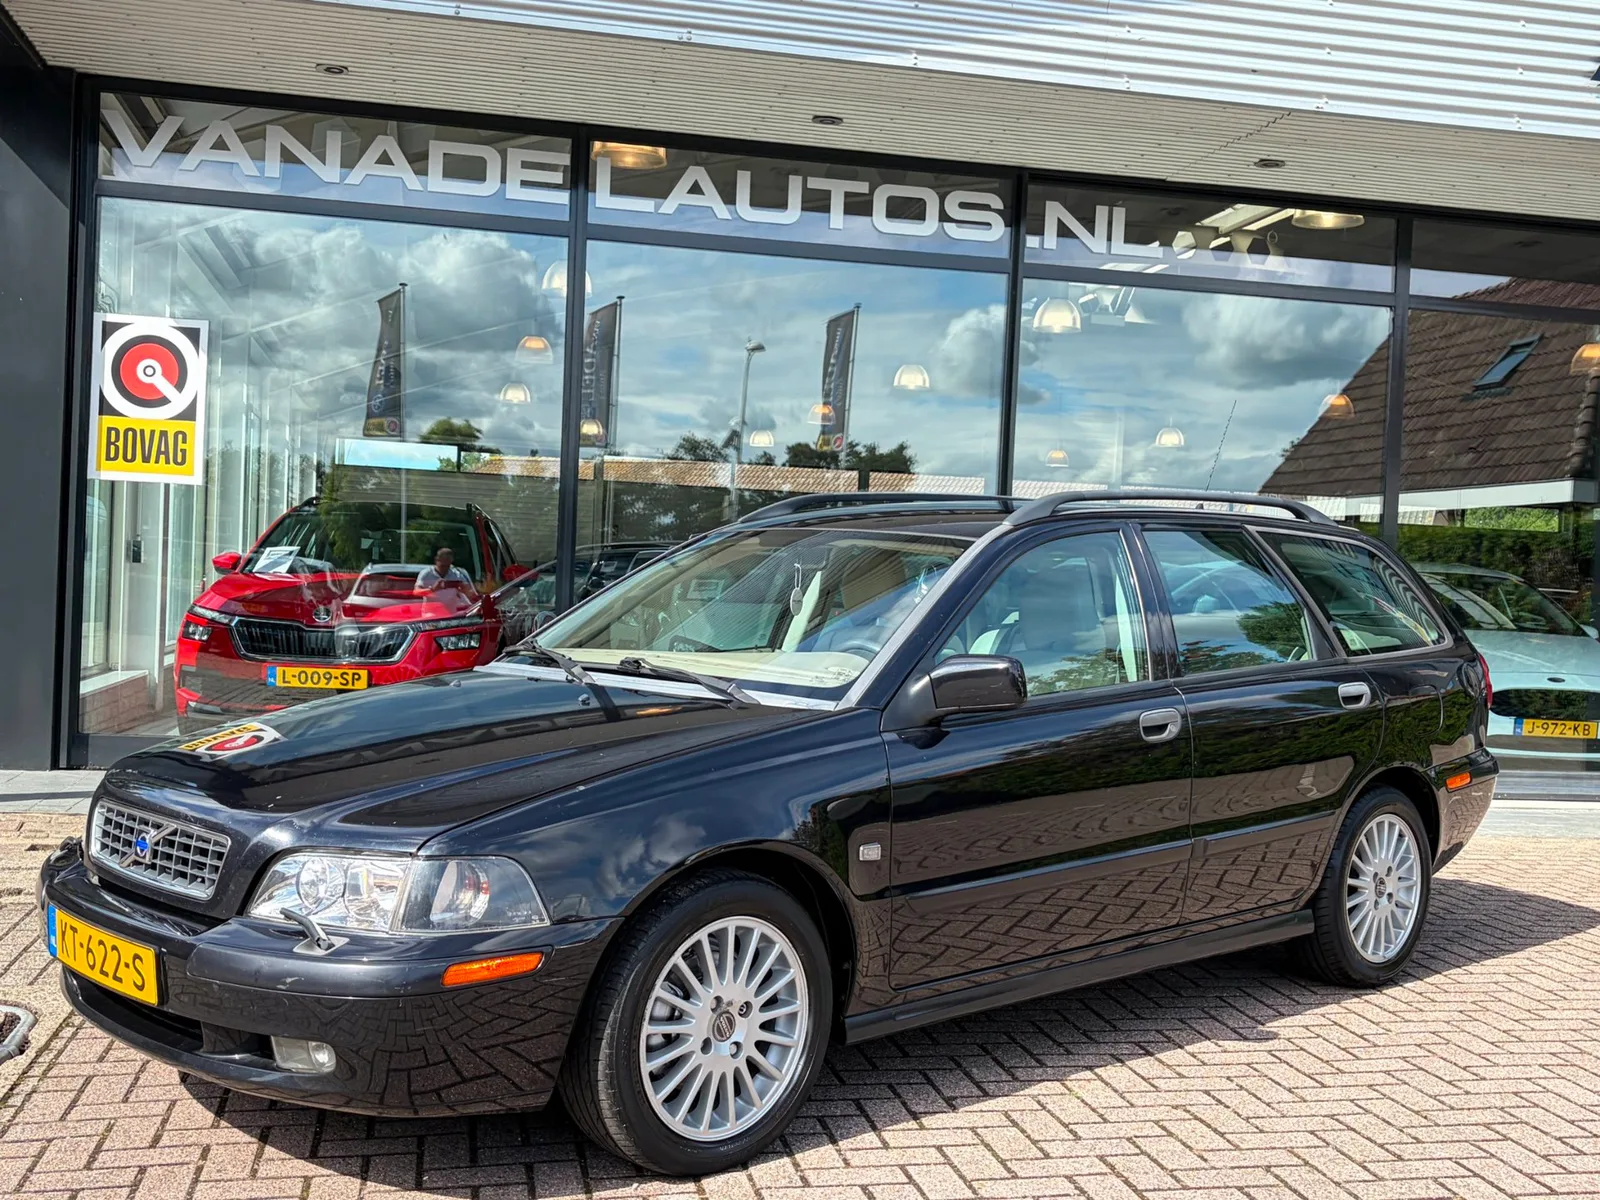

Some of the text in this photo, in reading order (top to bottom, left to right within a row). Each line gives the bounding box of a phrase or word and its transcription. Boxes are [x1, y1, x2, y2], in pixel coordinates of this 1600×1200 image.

[105, 427, 188, 466] BOVAG
[281, 669, 362, 687] L-009-SP
[1527, 721, 1591, 737] J-972-KB
[60, 919, 145, 991] KT-622-S
